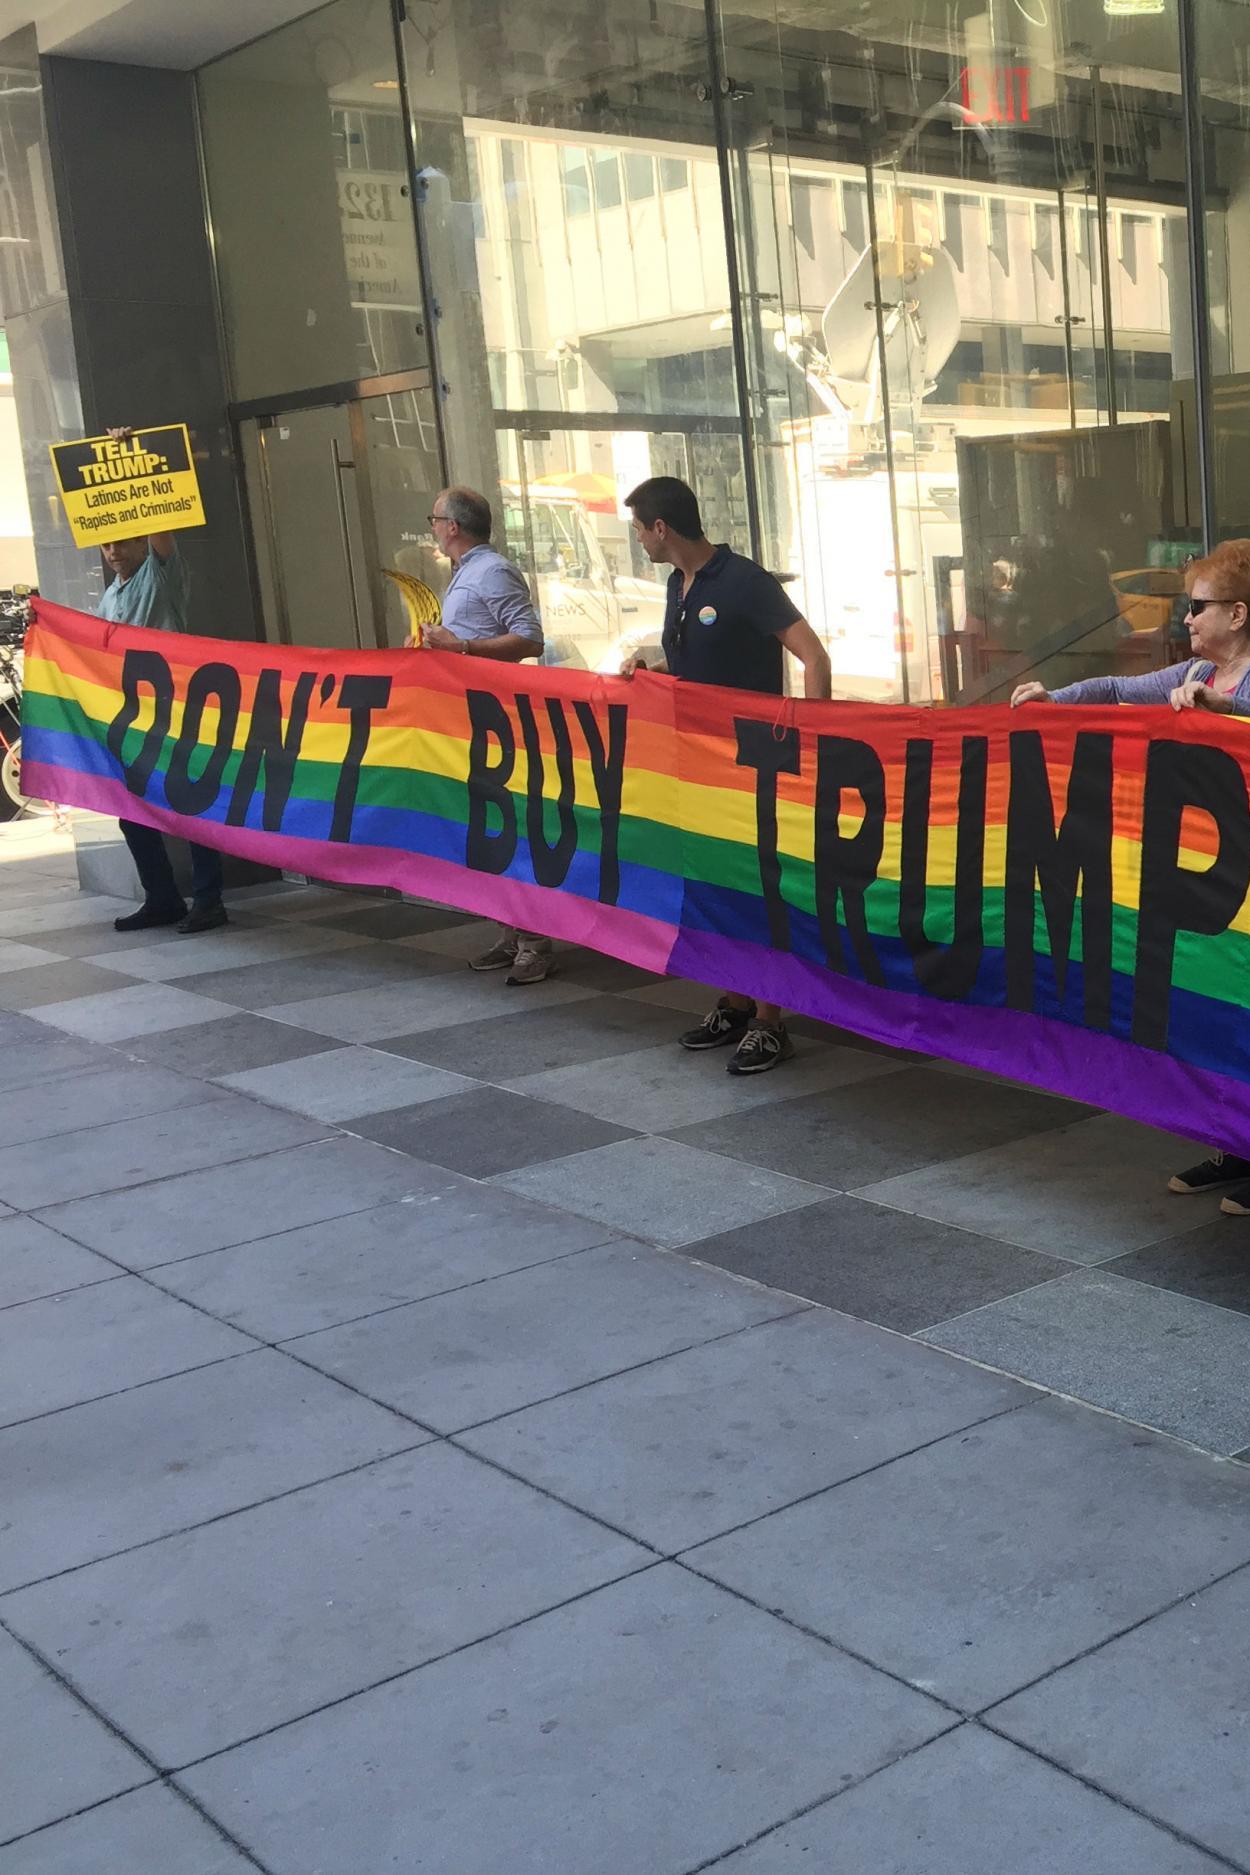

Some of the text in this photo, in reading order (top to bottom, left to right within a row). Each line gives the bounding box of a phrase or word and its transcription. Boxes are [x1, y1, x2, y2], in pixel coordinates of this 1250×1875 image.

[960, 66, 1031, 123] EXIT
[91, 437, 147, 462] TELL
[78, 453, 169, 485] TRUMP:
[84, 478, 175, 509] Latinos Are Not
[73, 496, 197, 532] “Rapists and Criminals”
[545, 603, 586, 617] NEWS
[108, 649, 392, 842] DON'T
[466, 688, 628, 906] BUY
